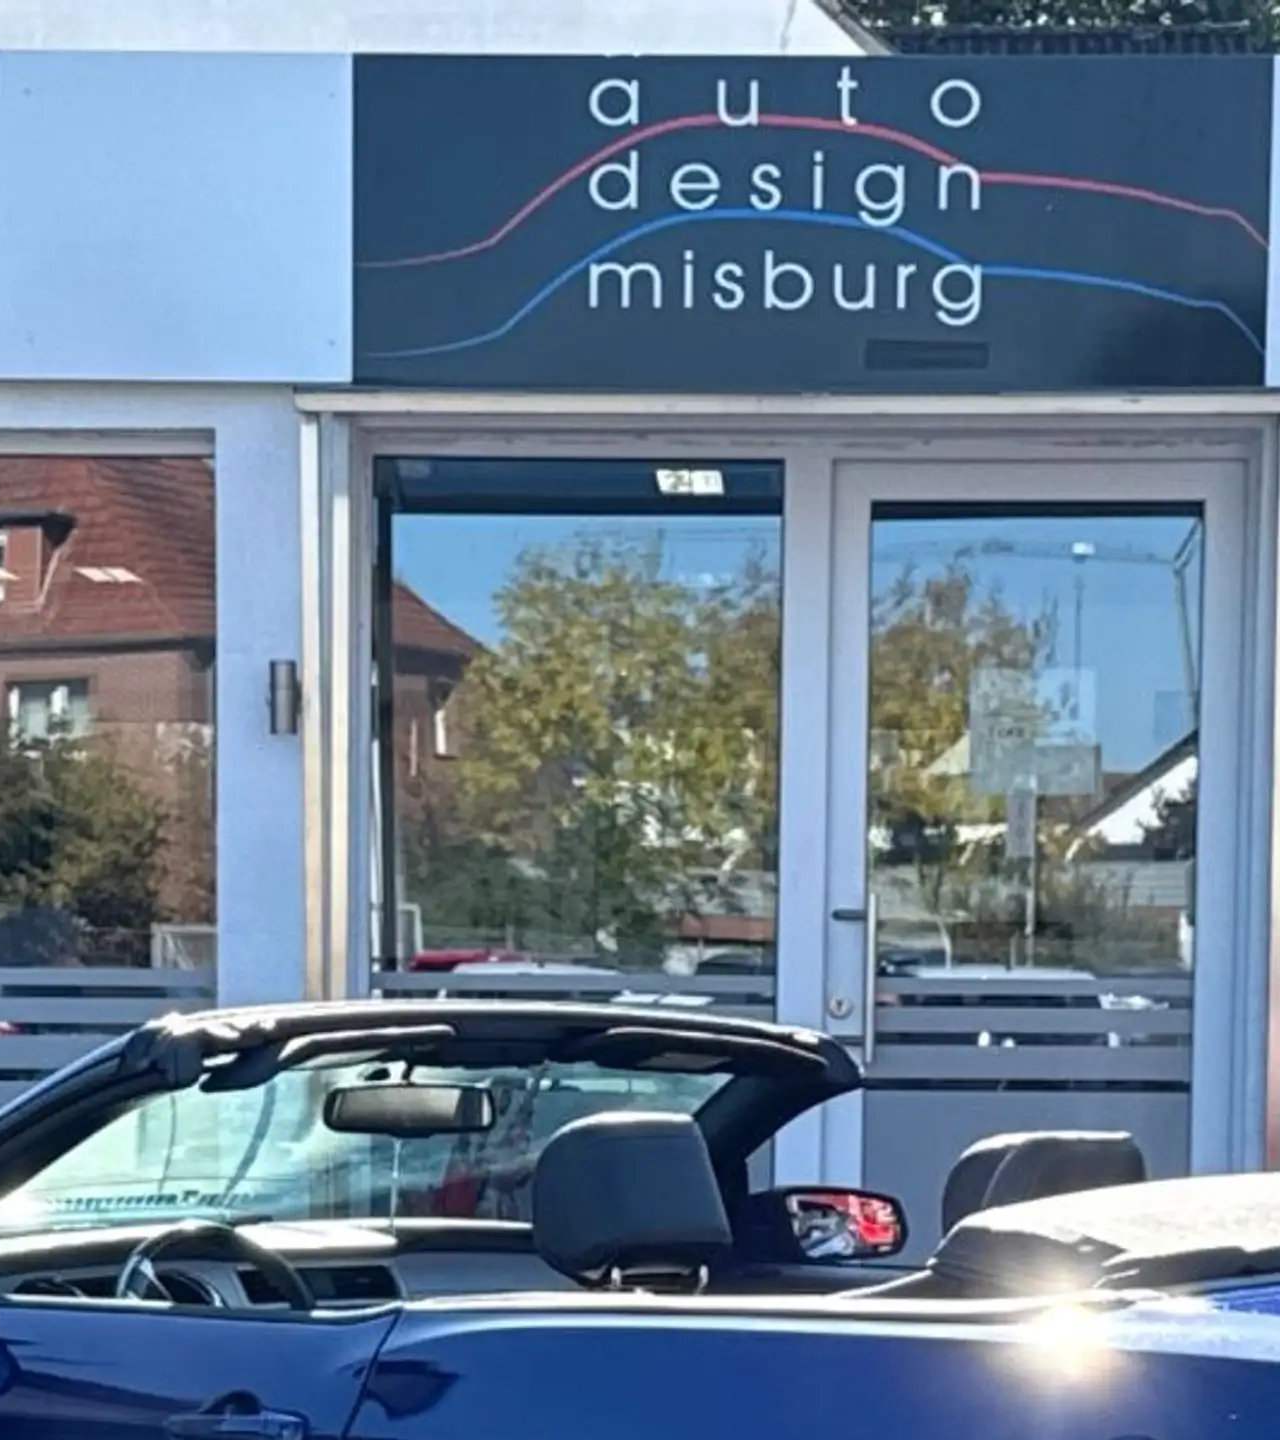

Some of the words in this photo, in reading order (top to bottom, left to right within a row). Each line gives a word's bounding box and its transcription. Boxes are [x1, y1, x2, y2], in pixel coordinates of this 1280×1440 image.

[587, 66, 982, 128] auto
[587, 150, 982, 227] design
[587, 249, 984, 326] misburg
